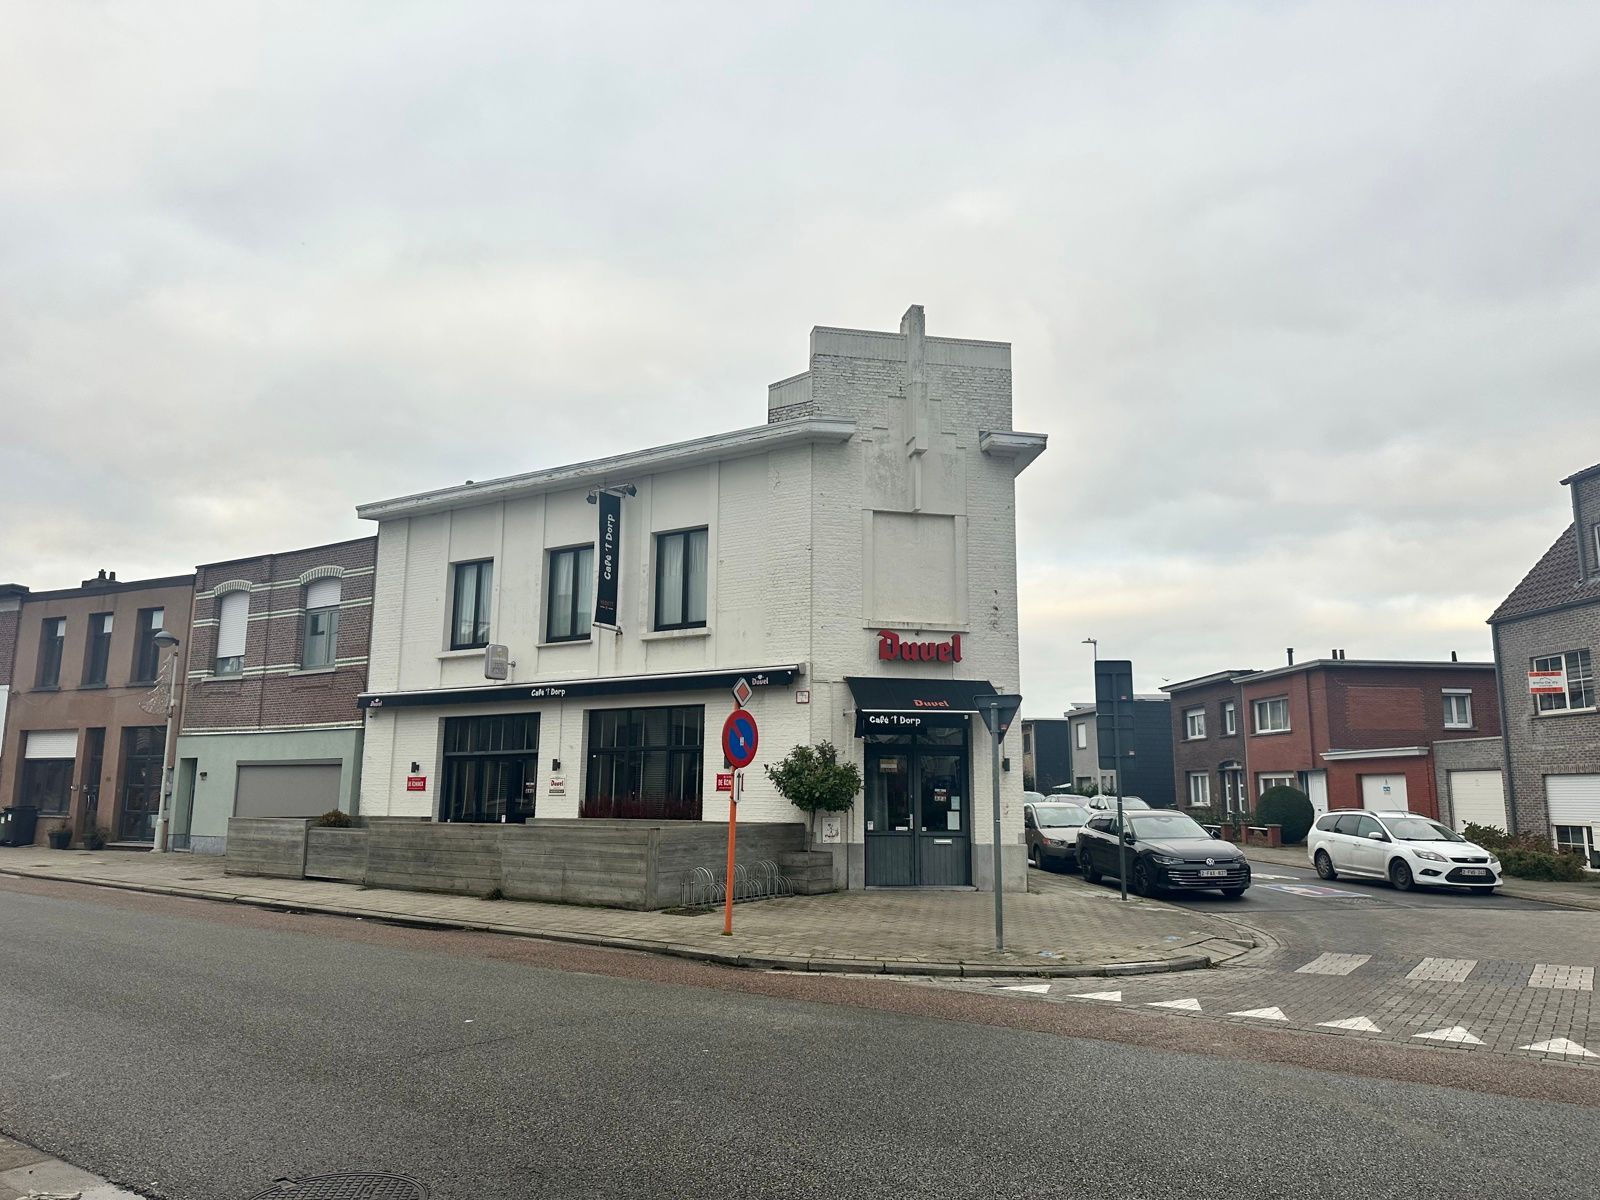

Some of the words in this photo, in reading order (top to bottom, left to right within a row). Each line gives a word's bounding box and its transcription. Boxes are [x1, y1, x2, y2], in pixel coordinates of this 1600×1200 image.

[606, 514, 615, 541] Dorp
[877, 629, 962, 663] Duvel
[550, 687, 566, 697] Dorp
[912, 699, 950, 707] Duvel
[869, 715, 889, 724] Café
[899, 715, 921, 727] Dorp
